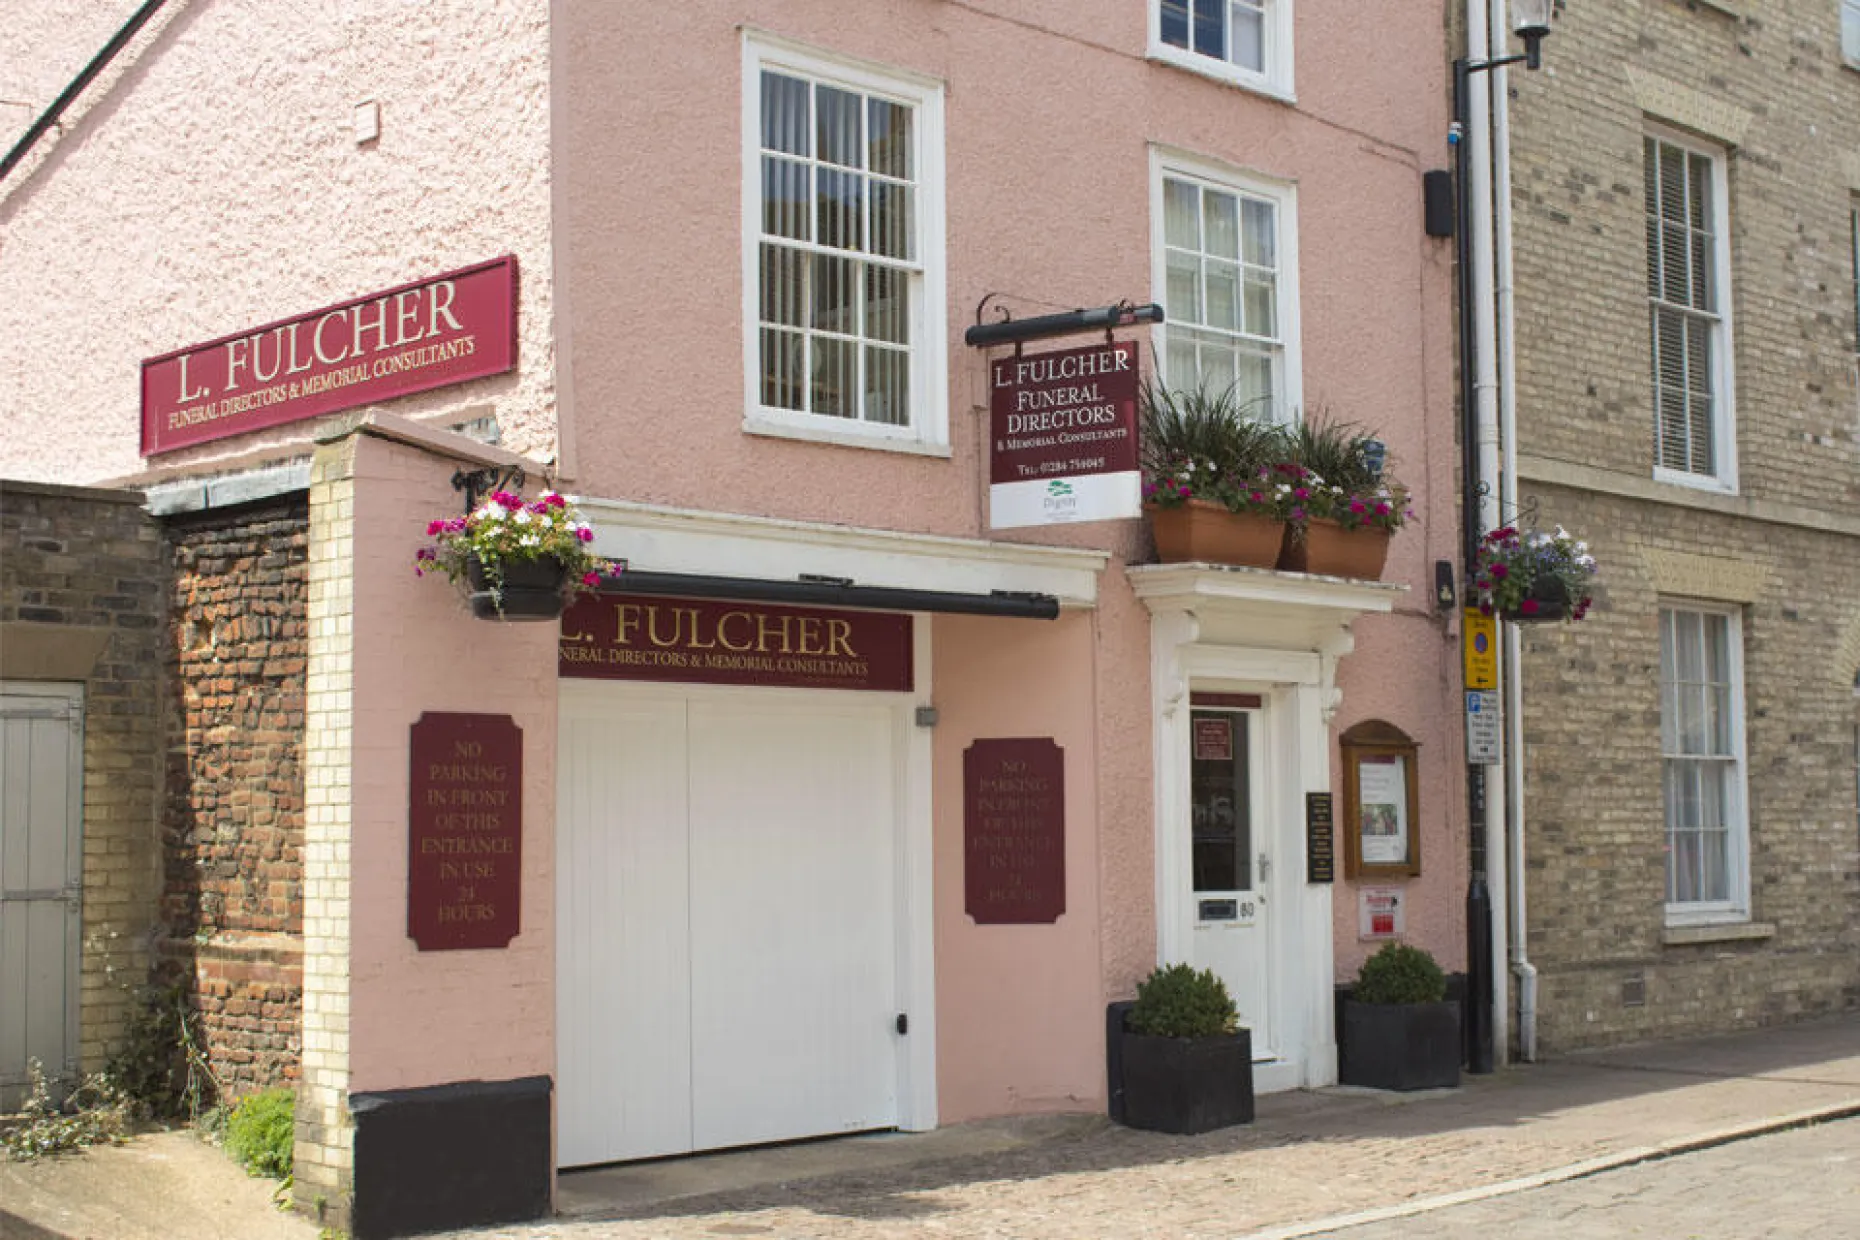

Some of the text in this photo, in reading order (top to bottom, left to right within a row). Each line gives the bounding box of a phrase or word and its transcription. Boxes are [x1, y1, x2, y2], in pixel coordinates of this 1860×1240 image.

[175, 280, 464, 404] L. FULCHER
[995, 350, 1130, 388] L. FULCHER
[168, 335, 476, 431] FUNERAL DIRECTORS & MEMORIAL CONSULTANTS
[1018, 384, 1104, 411] FUNERAL
[1007, 404, 1116, 435] DIRECTORS
[613, 603, 858, 658] FULCHER
[609, 648, 687, 668] DIRECTORS
[689, 652, 700, 667] &
[704, 652, 775, 671] MEMORIAL
[777, 657, 869, 676] CONSULTANTS
[454, 740, 482, 758] NO
[429, 762, 507, 782] PARKING
[451, 788, 509, 806] FRONT
[421, 836, 514, 853] ENTRANCE
[438, 902, 495, 922] HOURS
